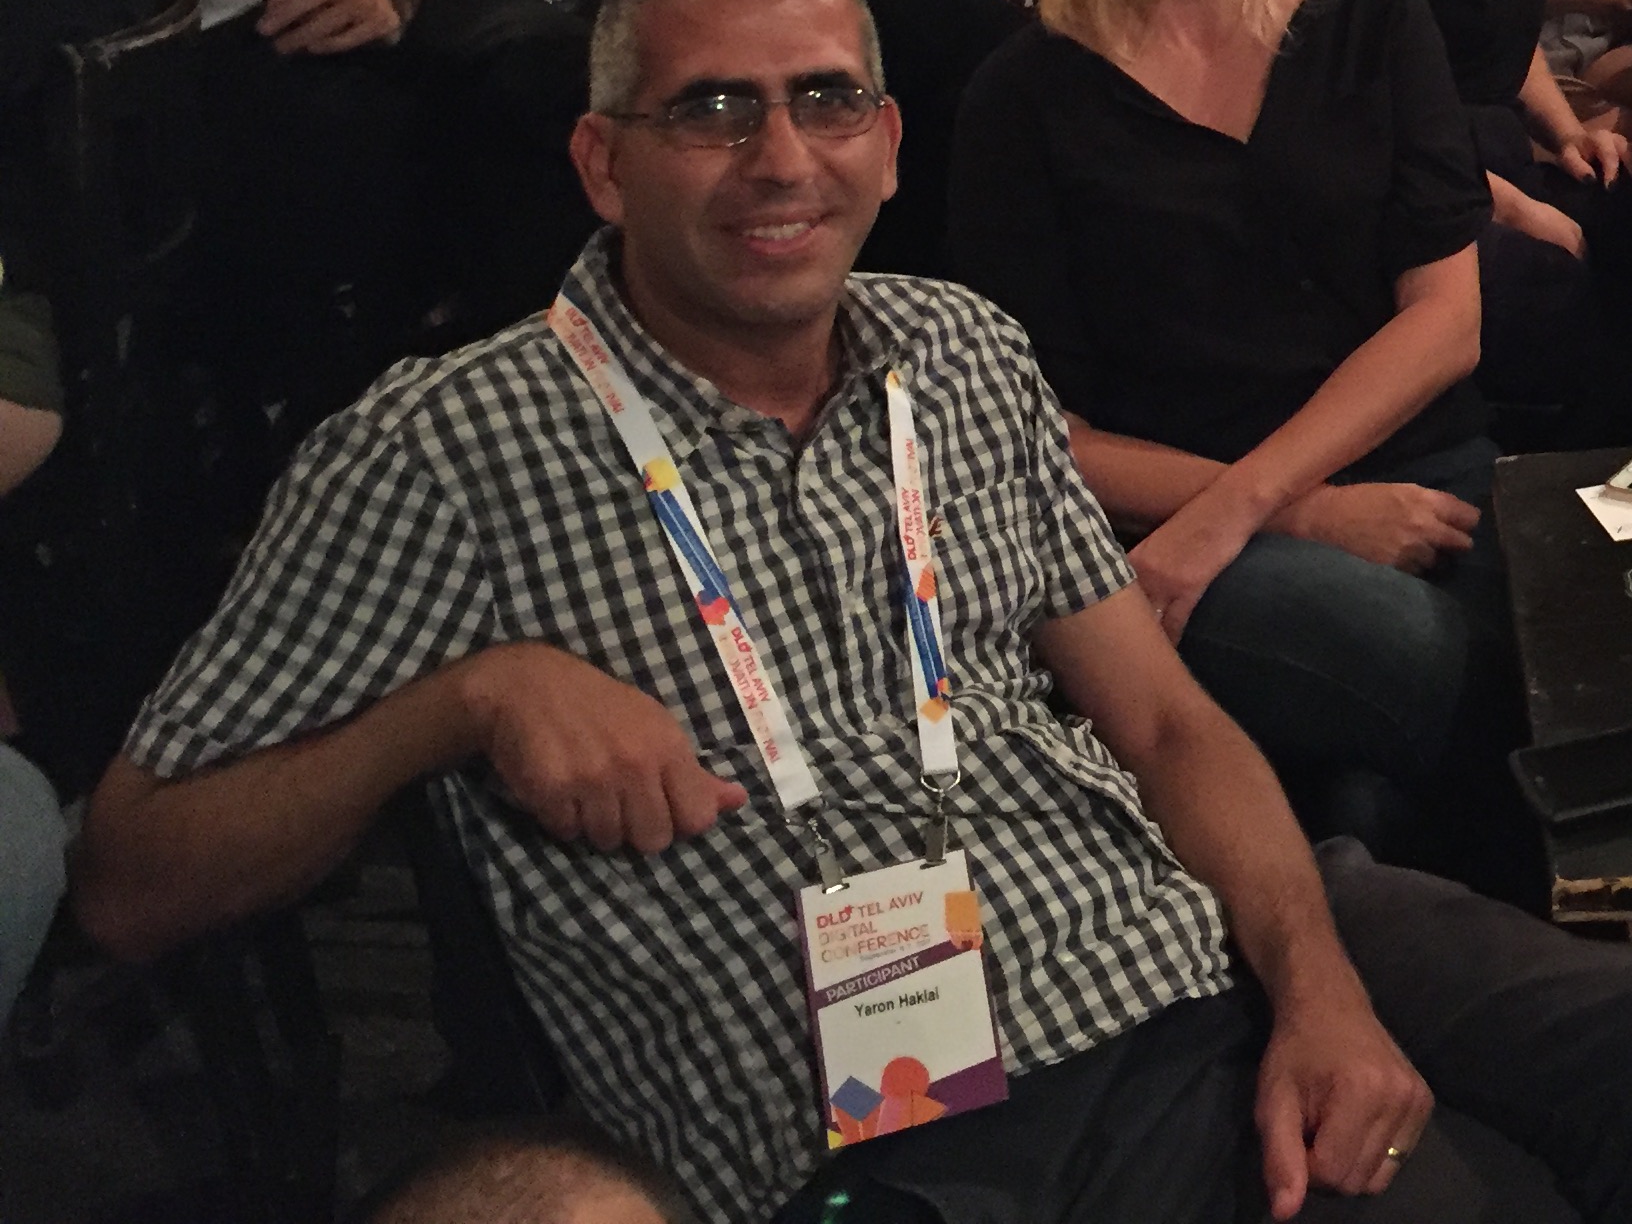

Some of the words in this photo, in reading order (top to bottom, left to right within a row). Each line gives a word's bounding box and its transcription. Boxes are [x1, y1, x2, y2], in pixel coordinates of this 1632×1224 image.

[731, 626, 753, 653] DLD
[744, 654, 758, 676] TEL
[752, 678, 771, 702] AVIV
[816, 905, 853, 929] DLD
[857, 902, 884, 918] TEL
[888, 891, 924, 910] AVIV
[819, 921, 878, 946] DGTAL
[825, 956, 920, 1002] PARTICIPANT
[854, 999, 895, 1018] Yaron
